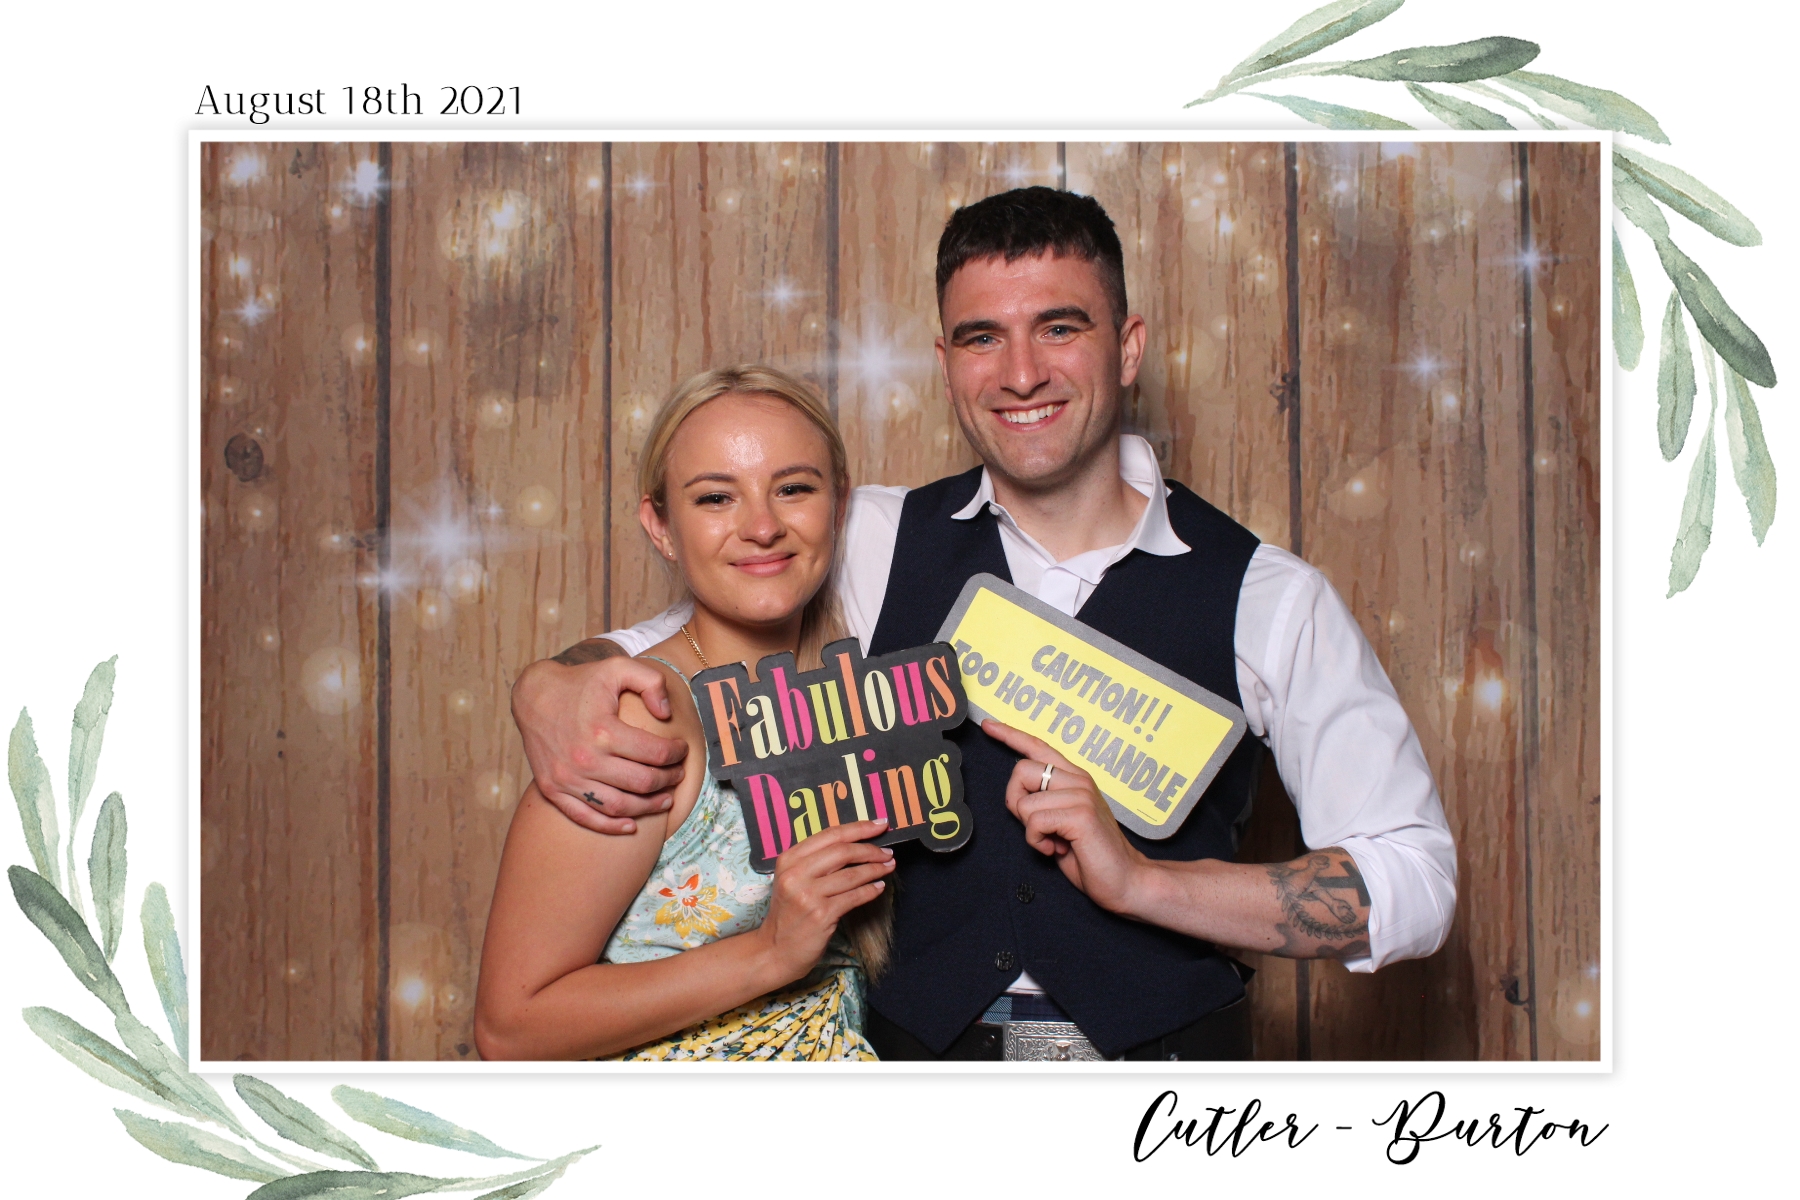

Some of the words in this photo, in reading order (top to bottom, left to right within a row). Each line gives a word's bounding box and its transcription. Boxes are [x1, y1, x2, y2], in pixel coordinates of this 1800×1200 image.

[703, 652, 957, 767] Fabulous
[954, 639, 999, 687] TOO
[994, 671, 1055, 721] HOT
[1047, 701, 1085, 744] TO
[1078, 724, 1188, 813] HANDLE
[1031, 644, 1173, 743] CAUTION!!
[744, 748, 960, 860] Darling
